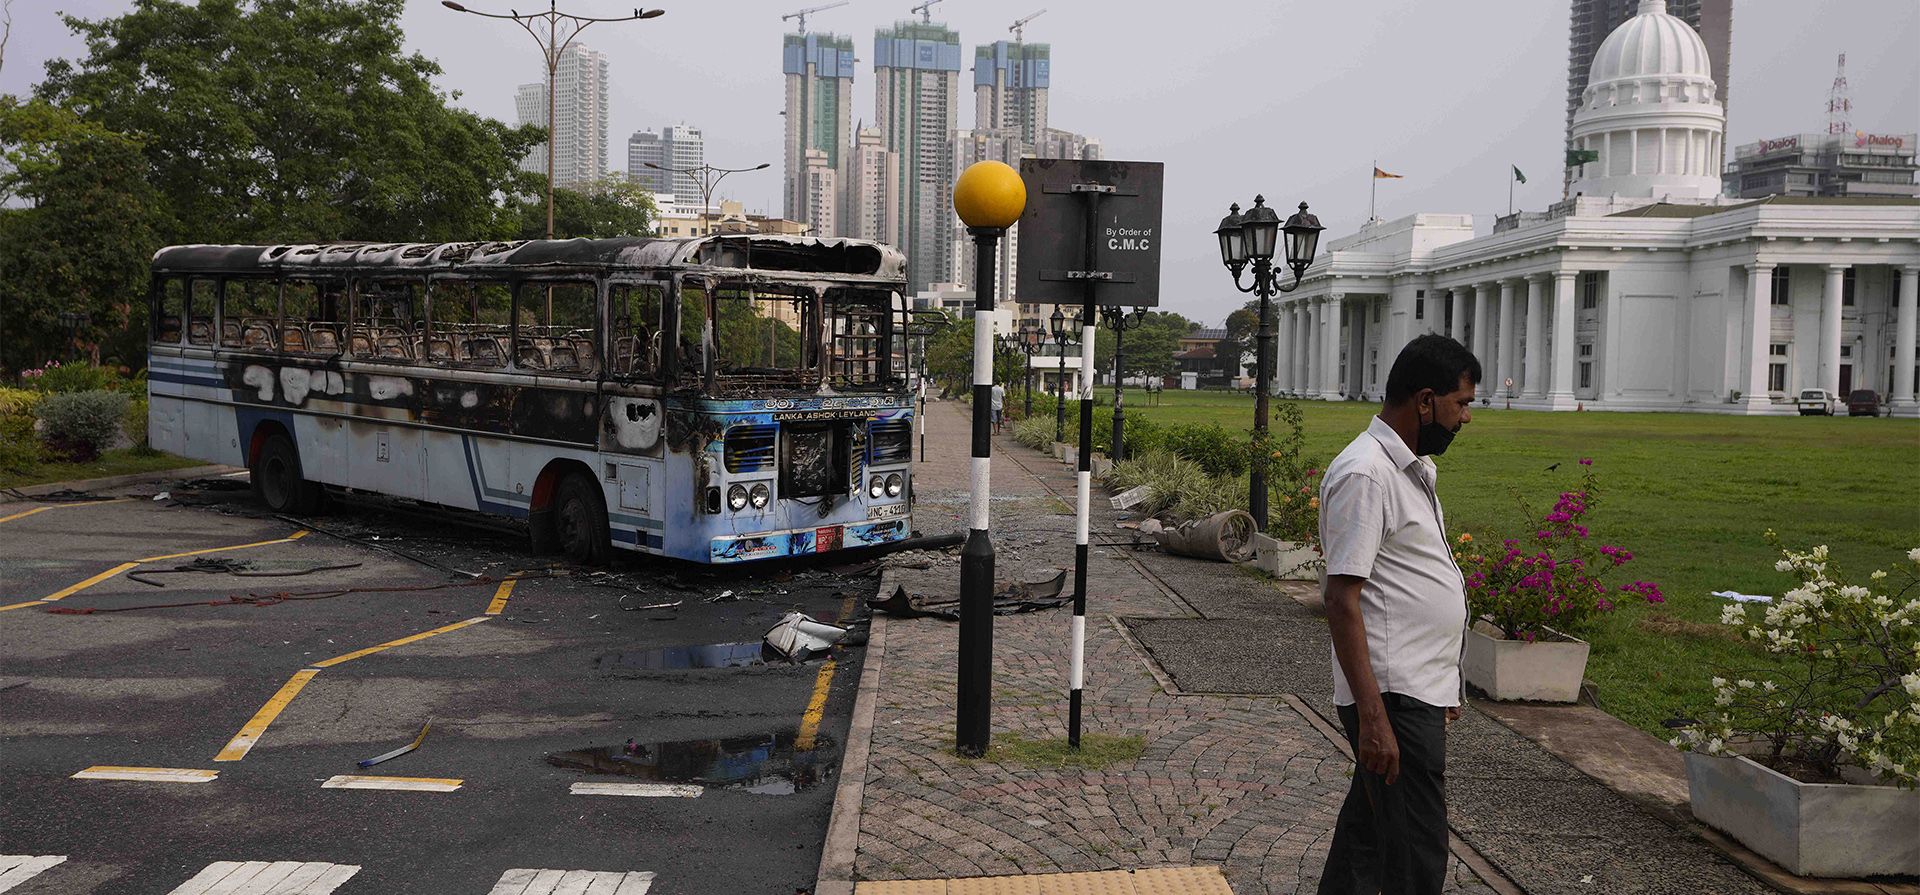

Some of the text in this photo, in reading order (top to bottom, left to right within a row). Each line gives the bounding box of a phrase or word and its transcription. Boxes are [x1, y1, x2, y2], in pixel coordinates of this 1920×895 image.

[1768, 137, 1797, 150] Dialog
[1867, 134, 1903, 147] Dialog
[1106, 227, 1152, 237] By Order of
[1108, 238, 1149, 250] C.M.C
[774, 410, 876, 421] LANKA ASHOK LEYLAND
